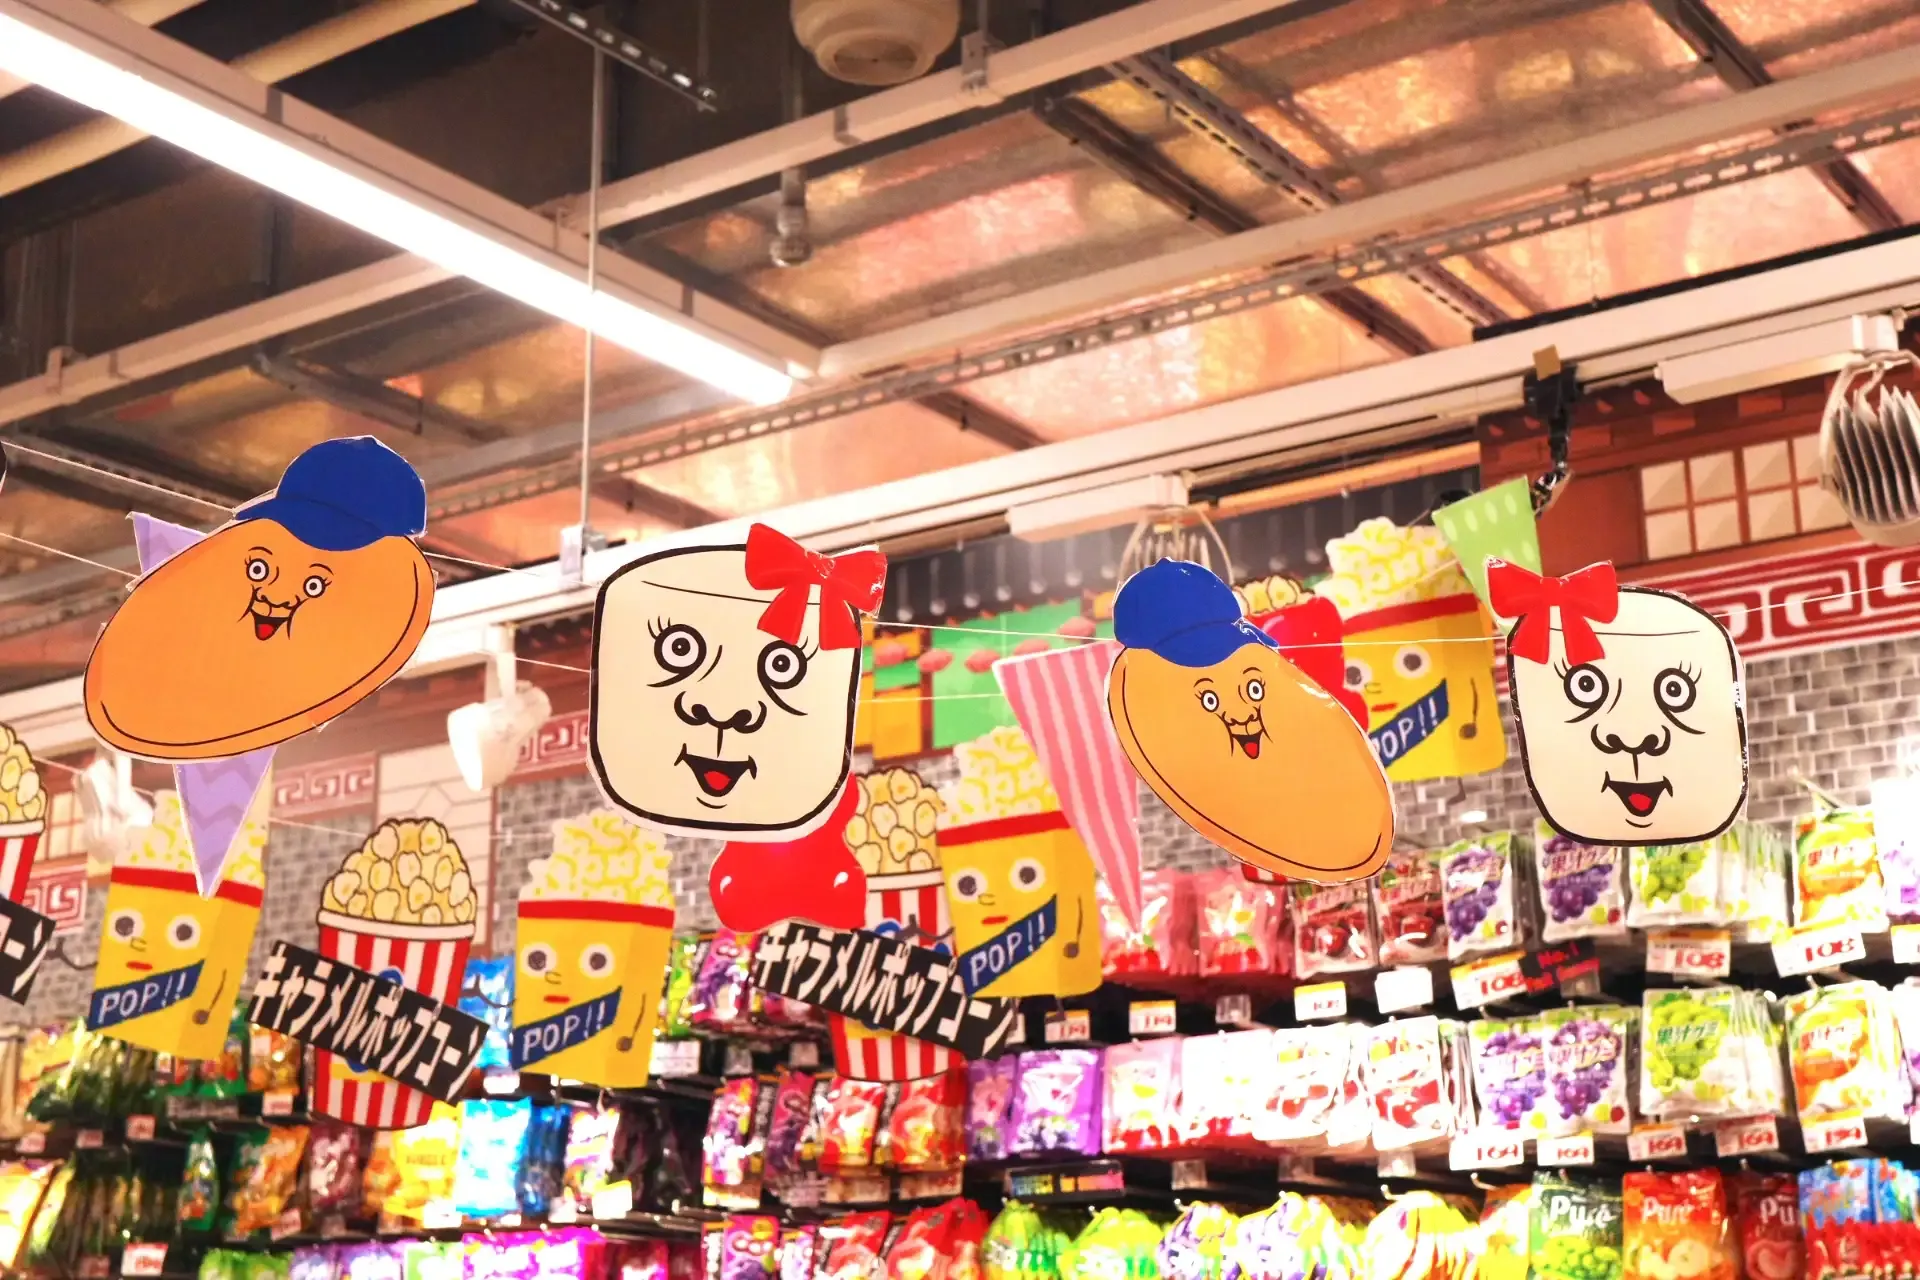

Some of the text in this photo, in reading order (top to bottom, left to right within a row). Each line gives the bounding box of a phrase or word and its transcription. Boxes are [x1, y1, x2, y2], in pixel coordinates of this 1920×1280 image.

[969, 911, 1046, 987] POP!!
[1675, 948, 1725, 969] 108
[1805, 938, 1855, 962] 108
[98, 971, 187, 1024] POP!!
[250, 943, 483, 1101] キャラメルポップコーン
[522, 1000, 606, 1062] POP!!
